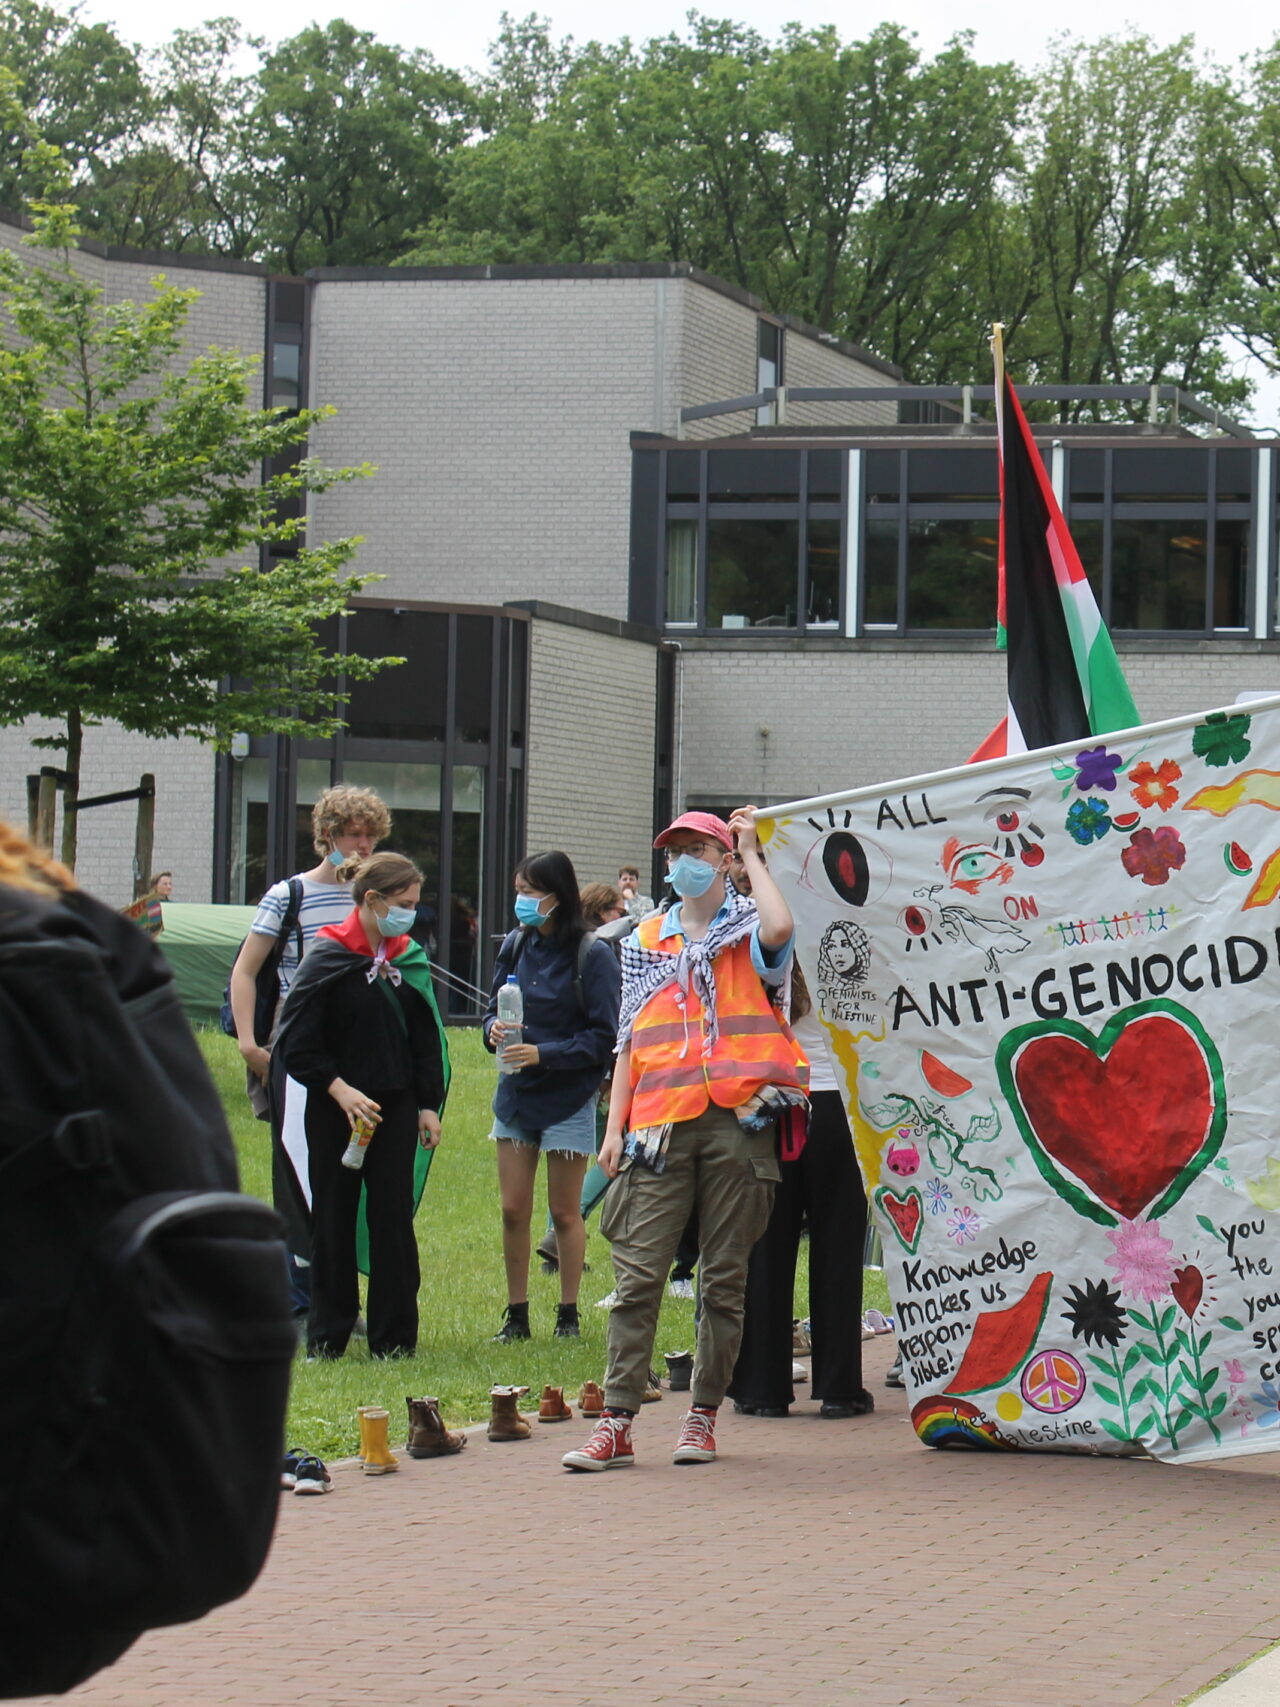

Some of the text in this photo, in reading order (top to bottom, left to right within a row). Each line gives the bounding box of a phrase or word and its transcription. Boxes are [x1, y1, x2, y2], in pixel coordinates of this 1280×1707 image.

[876, 793, 948, 831] ALL
[1004, 895, 1039, 921] ON
[828, 987, 877, 1001] FEMINISTS
[837, 1001, 860, 1010] FOR
[831, 1008, 877, 1025] PALESTINE
[1220, 1219, 1265, 1258] you
[902, 1237, 1038, 1293] Knowledge
[1231, 1255, 1272, 1280] the
[896, 1282, 1007, 1332] makes us
[898, 1322, 972, 1361] respon-
[910, 1349, 955, 1388] sible!
